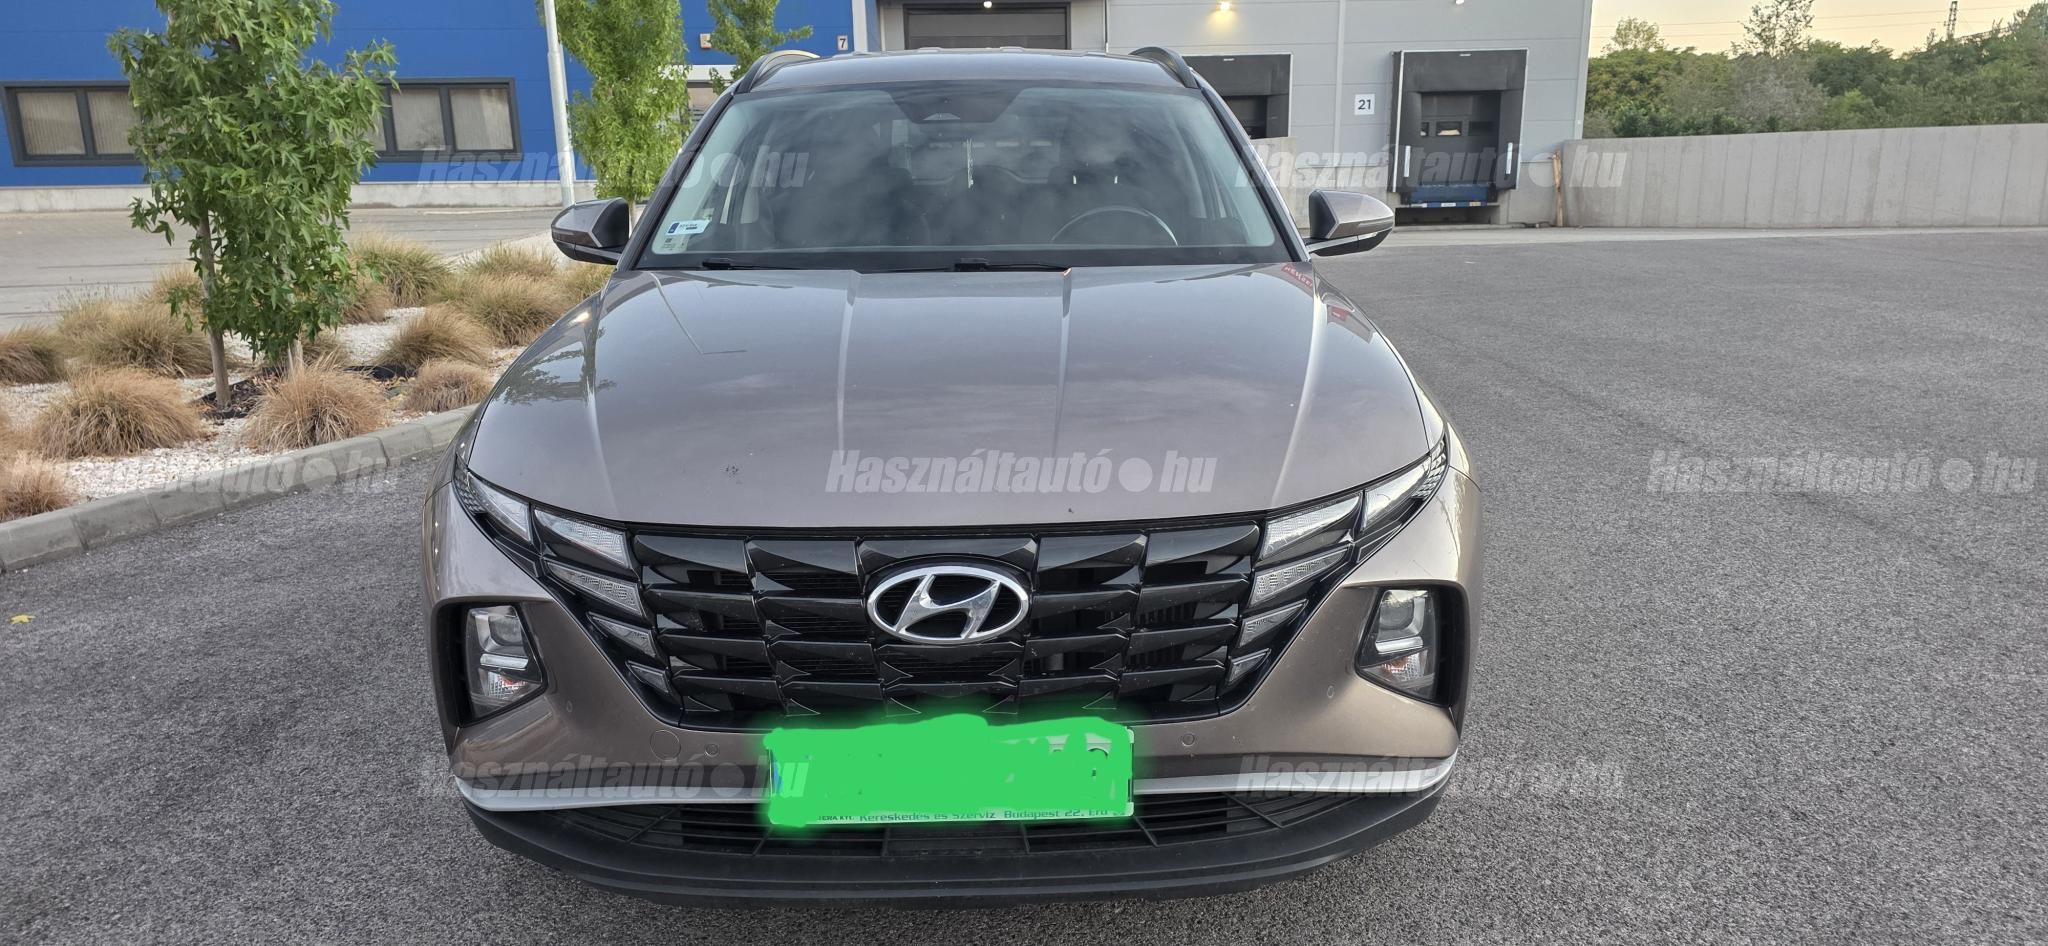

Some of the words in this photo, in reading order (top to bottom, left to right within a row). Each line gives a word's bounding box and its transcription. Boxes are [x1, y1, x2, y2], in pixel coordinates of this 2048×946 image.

[840, 38, 847, 49] 7
[1358, 99, 1371, 110] 21
[1004, 809, 1059, 820] Budapest
